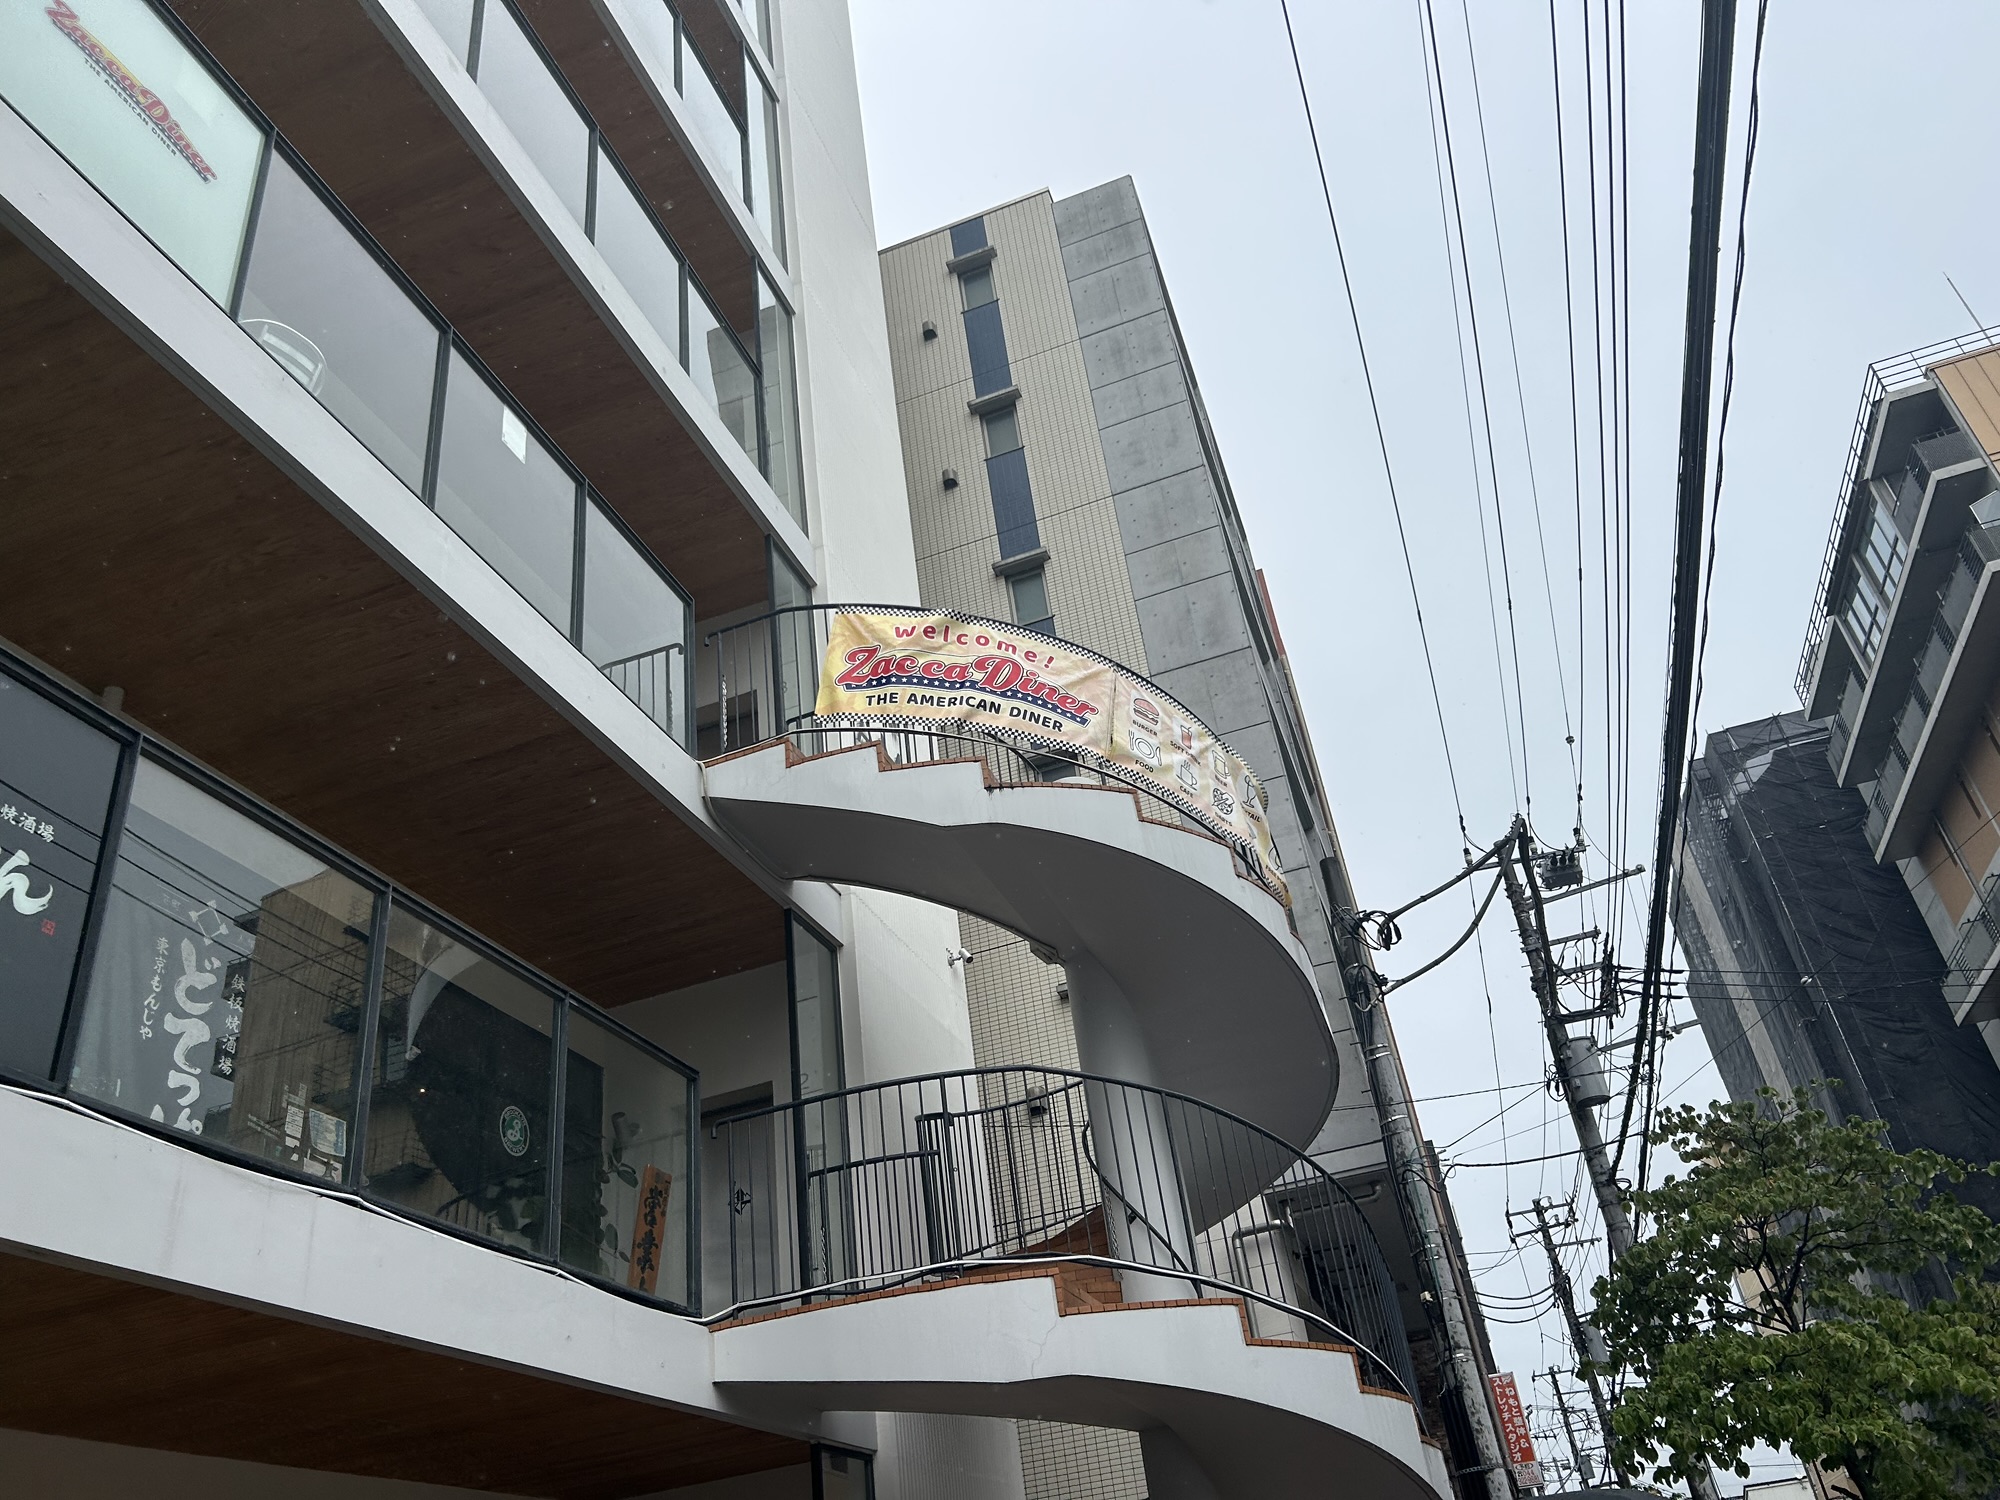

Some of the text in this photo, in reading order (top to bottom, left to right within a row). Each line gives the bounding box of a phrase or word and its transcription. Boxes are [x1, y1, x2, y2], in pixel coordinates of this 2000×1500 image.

[44, 0, 218, 181] Zacca Diner
[84, 57, 177, 156] THE AMERICAN DINER
[895, 624, 1055, 669] welcome!
[836, 645, 1099, 717] Zacca Diner
[865, 692, 1064, 732] THE AMERICAN DINER
[1132, 719, 1159, 737] BURGER
[1135, 759, 1154, 774] FOOD
[1170, 740, 1186, 754] SOFT
[0, 803, 55, 843] 焼酒場
[218, 973, 246, 1076] 鉄板焼酒場
